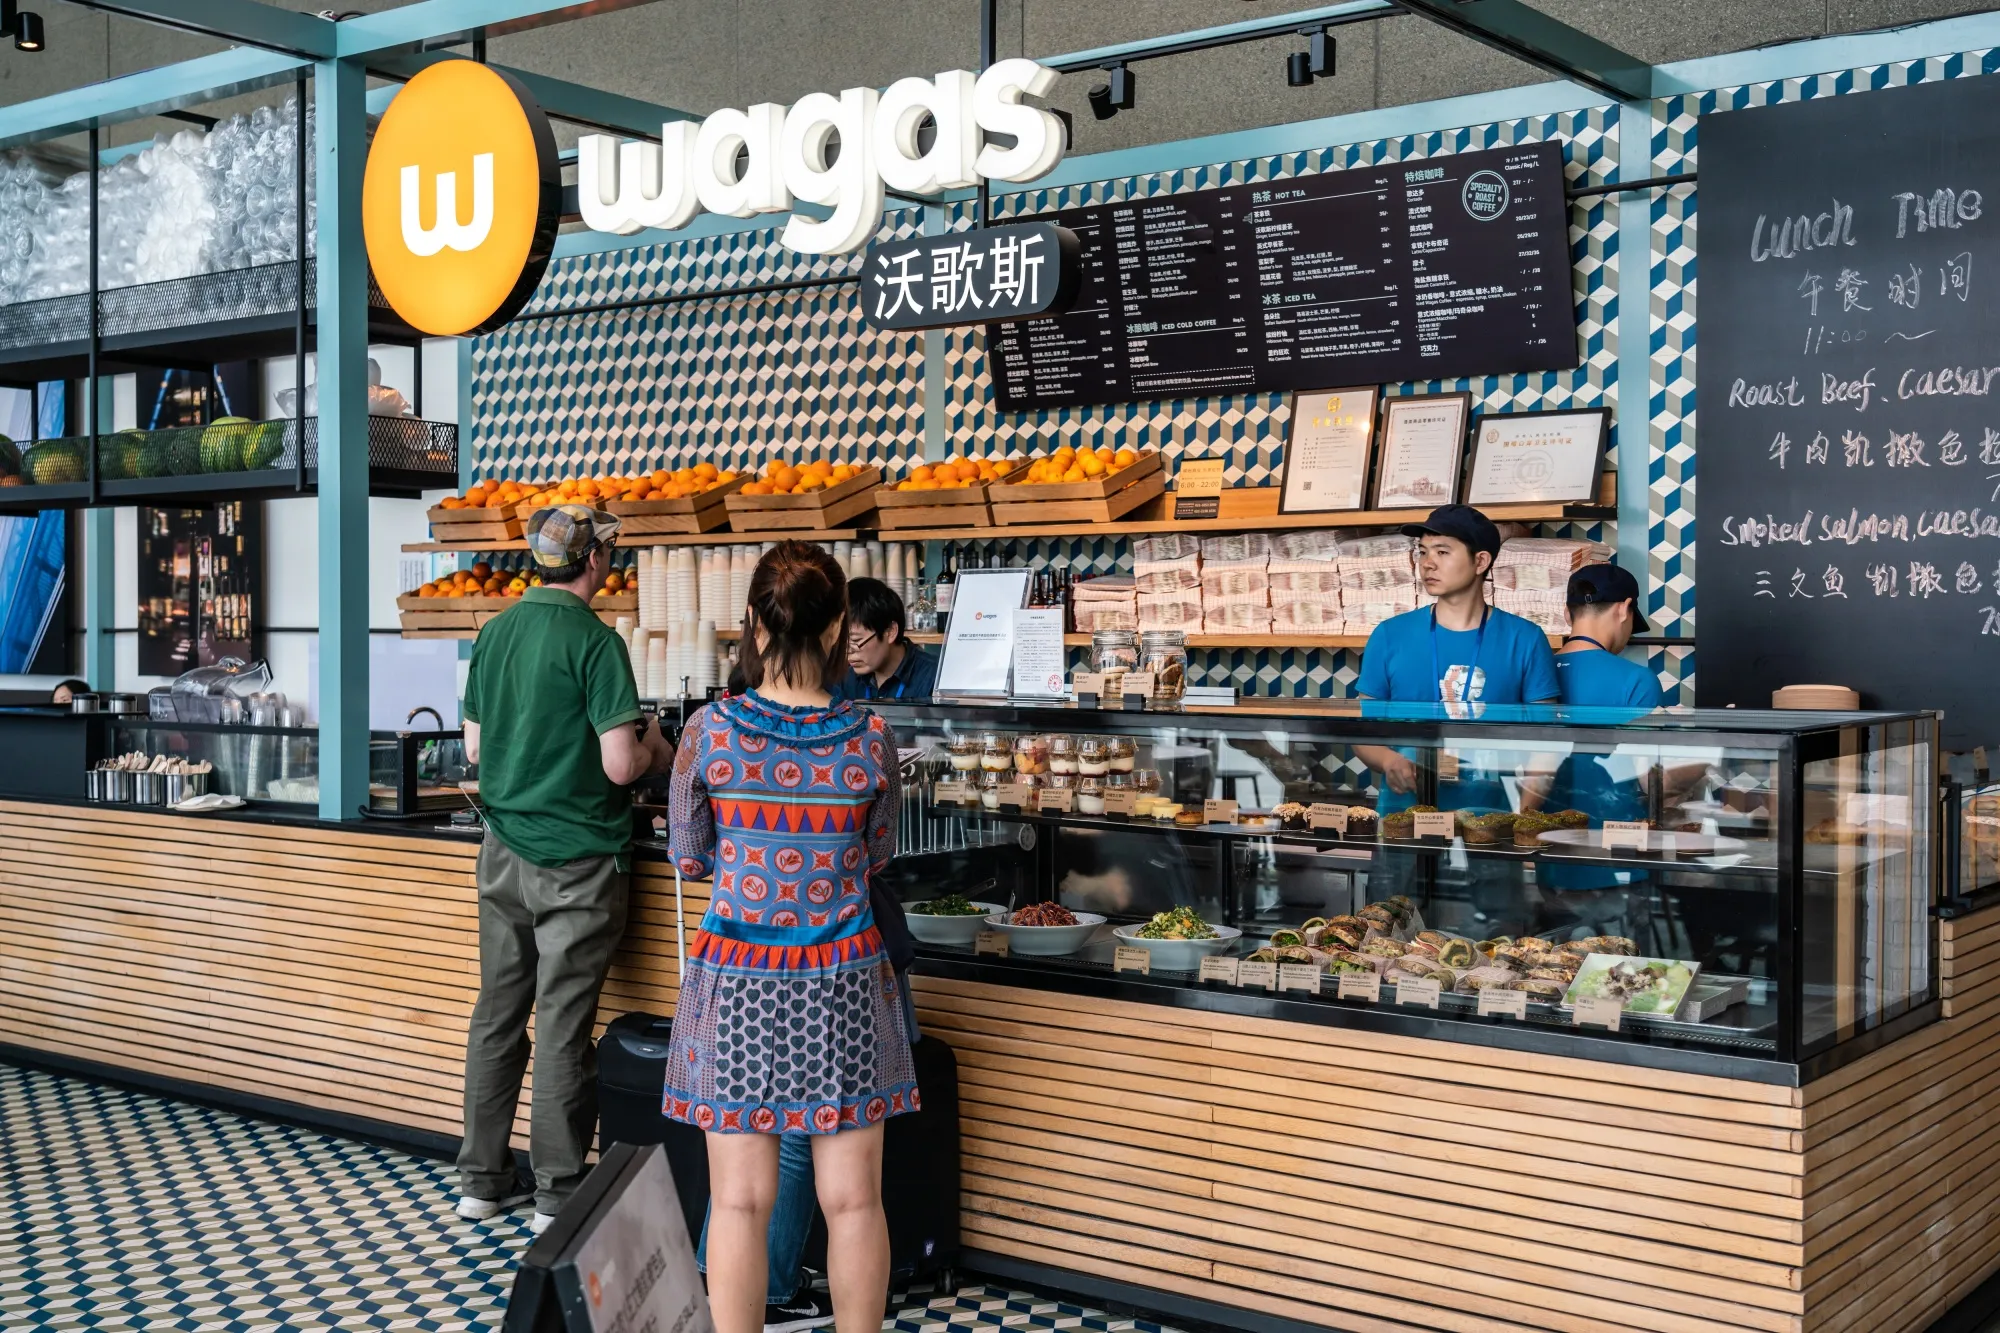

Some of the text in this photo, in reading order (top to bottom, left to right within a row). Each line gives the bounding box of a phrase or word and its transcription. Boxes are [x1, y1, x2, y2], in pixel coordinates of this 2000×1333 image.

[577, 58, 1064, 255] wagas
[1405, 167, 1444, 183] 特焙咖啡
[1252, 190, 1306, 203] 热茶 HOT TEA
[1470, 182, 1503, 194] SPECIALTY
[1474, 193, 1496, 203] ROAST
[1472, 202, 1497, 213] COFFEE
[1750, 197, 1857, 262] Lunch
[872, 232, 1046, 320] 沃歌斯
[1797, 252, 1972, 316] 午餐时间
[1262, 293, 1281, 305] 冰茶
[1803, 325, 1867, 355] 11:00
[1728, 376, 1804, 408] Roast
